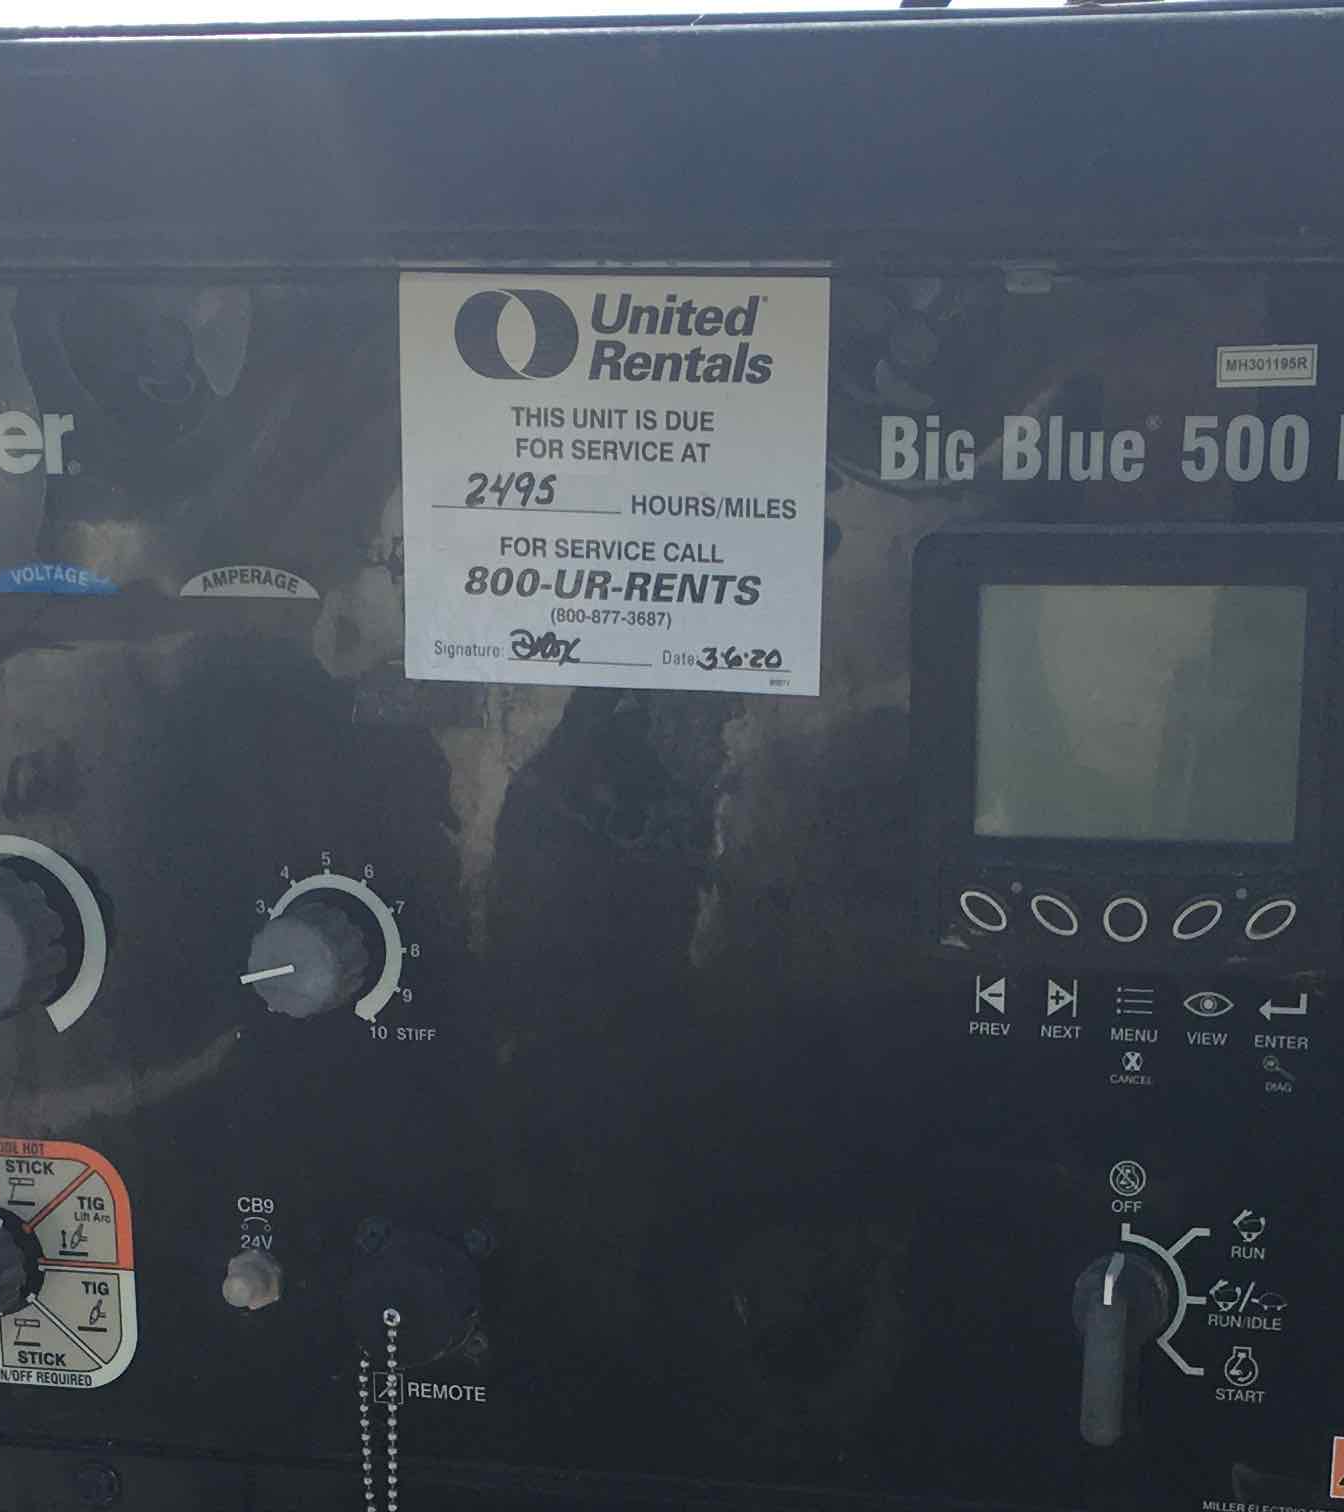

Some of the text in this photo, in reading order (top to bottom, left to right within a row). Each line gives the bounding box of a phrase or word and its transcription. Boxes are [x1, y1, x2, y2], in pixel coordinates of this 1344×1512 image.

[591, 293, 758, 337] United
[588, 340, 773, 385] Rentals
[1225, 356, 1309, 374] MH301195R
[512, 406, 715, 432] THIS UNIT IS DUE
[515, 438, 711, 463] FOR SERVICE AT
[1002, 415, 1146, 482] Blue
[1181, 414, 1311, 482] 500
[465, 471, 557, 508] 2495
[631, 495, 797, 520] HOURS/MILES
[500, 536, 724, 564] FOR SERVICE CALL
[10, 563, 89, 588] VOLTAGE
[201, 566, 299, 595] AMPERAGE
[464, 566, 762, 606] 800-UR-RENTS
[550, 608, 672, 631] (800-877-3687)
[434, 640, 505, 660] Signature:
[320, 852, 331, 865] 5
[280, 865, 289, 879] 4
[364, 865, 374, 879] 6
[256, 900, 265, 914] 3
[395, 901, 405, 914] 7
[411, 944, 420, 957] 8
[402, 990, 412, 1003] 9
[369, 1026, 436, 1042] 10 STIFF
[969, 1021, 1010, 1037] PREV
[1040, 1024, 1082, 1040] NEXT
[1110, 1027, 1158, 1044] MENU
[1186, 1031, 1228, 1047] VIEW
[1254, 1034, 1309, 1051] ENTER
[5, 1160, 55, 1176] STICK
[77, 1196, 105, 1211] TIG
[237, 1197, 274, 1214] CB9
[1111, 1200, 1143, 1214] OFF
[240, 1234, 273, 1250] 24V
[1231, 1245, 1265, 1261] RUN
[81, 1281, 109, 1296] TIG
[1207, 1313, 1282, 1331] RUN/IDLE
[17, 1350, 66, 1367] STICK
[37, 1370, 92, 1387] REQUIRED
[407, 1382, 486, 1402] REMOTE
[1215, 1387, 1265, 1404] START
